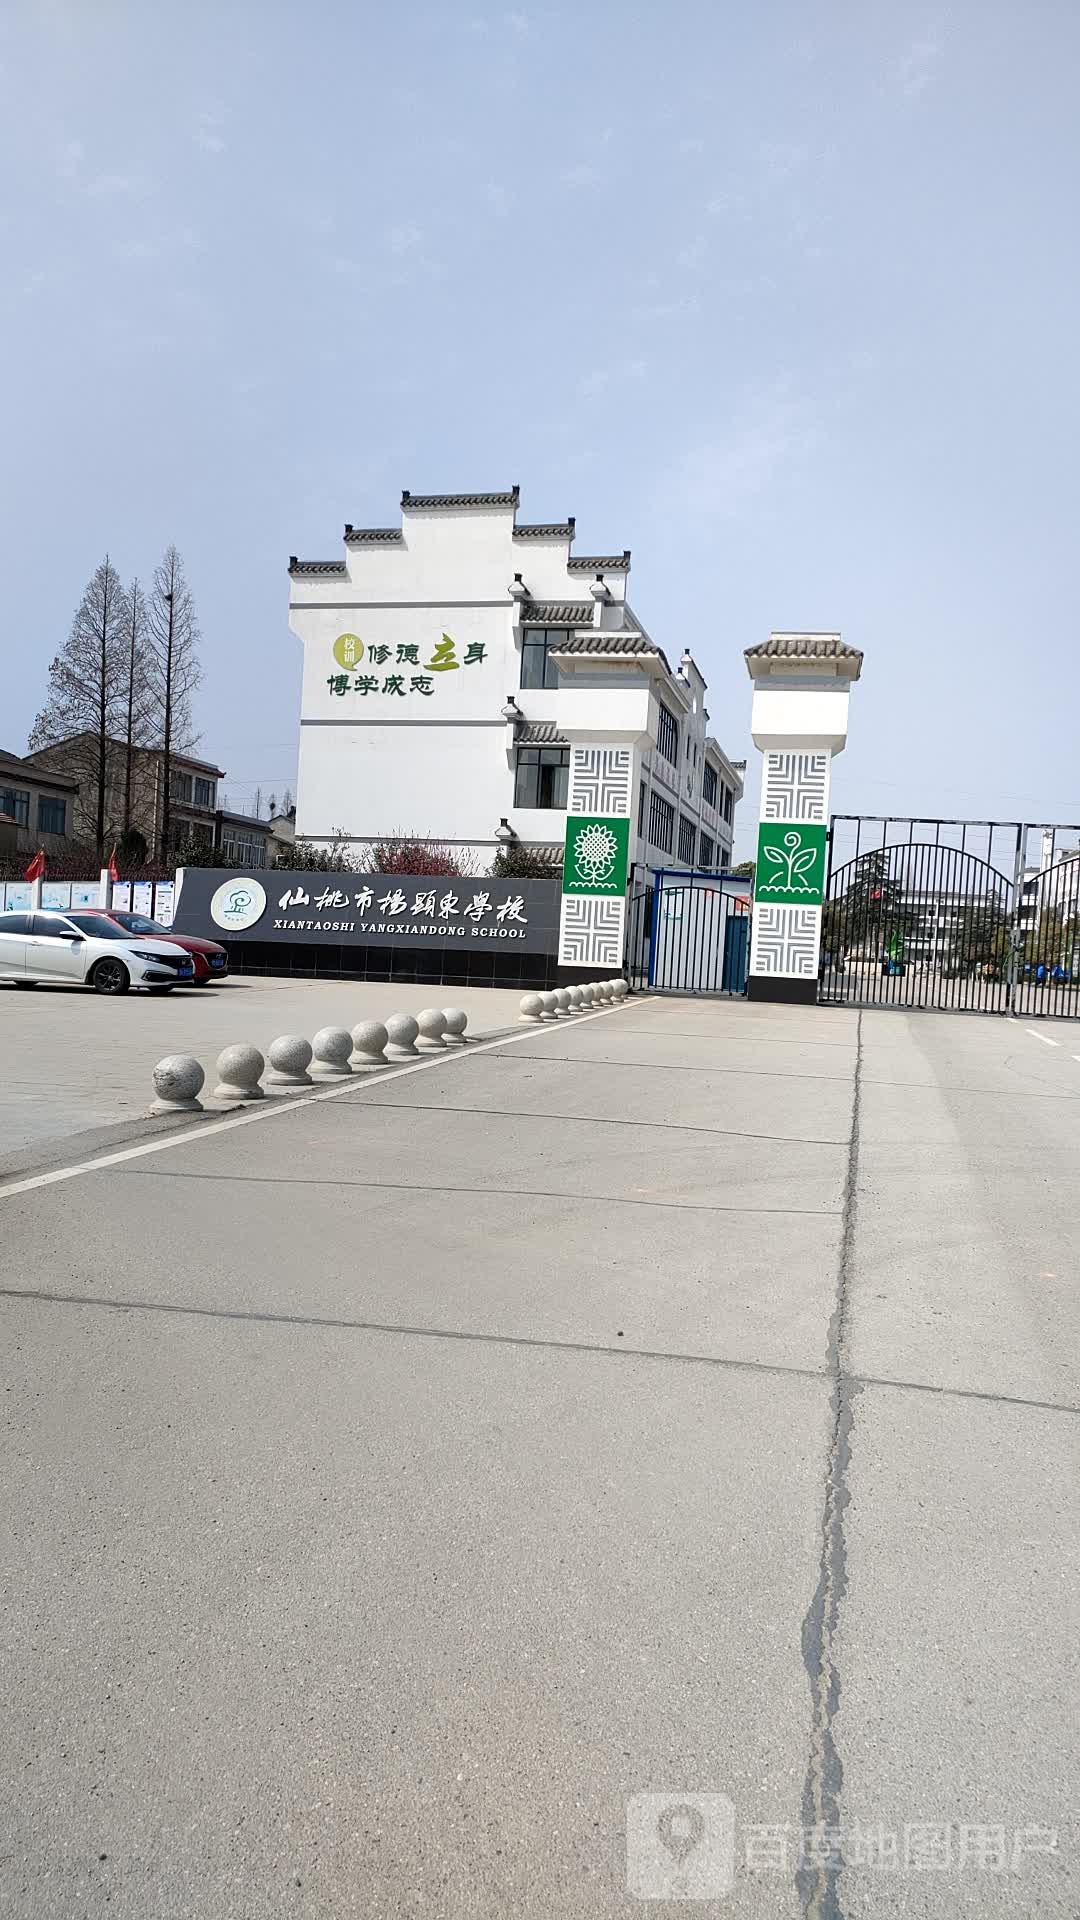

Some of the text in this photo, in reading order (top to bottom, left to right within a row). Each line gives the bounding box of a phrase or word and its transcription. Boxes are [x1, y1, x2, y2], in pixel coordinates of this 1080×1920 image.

[343, 637, 356, 663] 校训
[367, 633, 488, 672] 修德立身
[327, 674, 435, 696] 博学成志
[273, 919, 526, 939] XIANTAOSHI YANGXIANDONG SCHOOL
